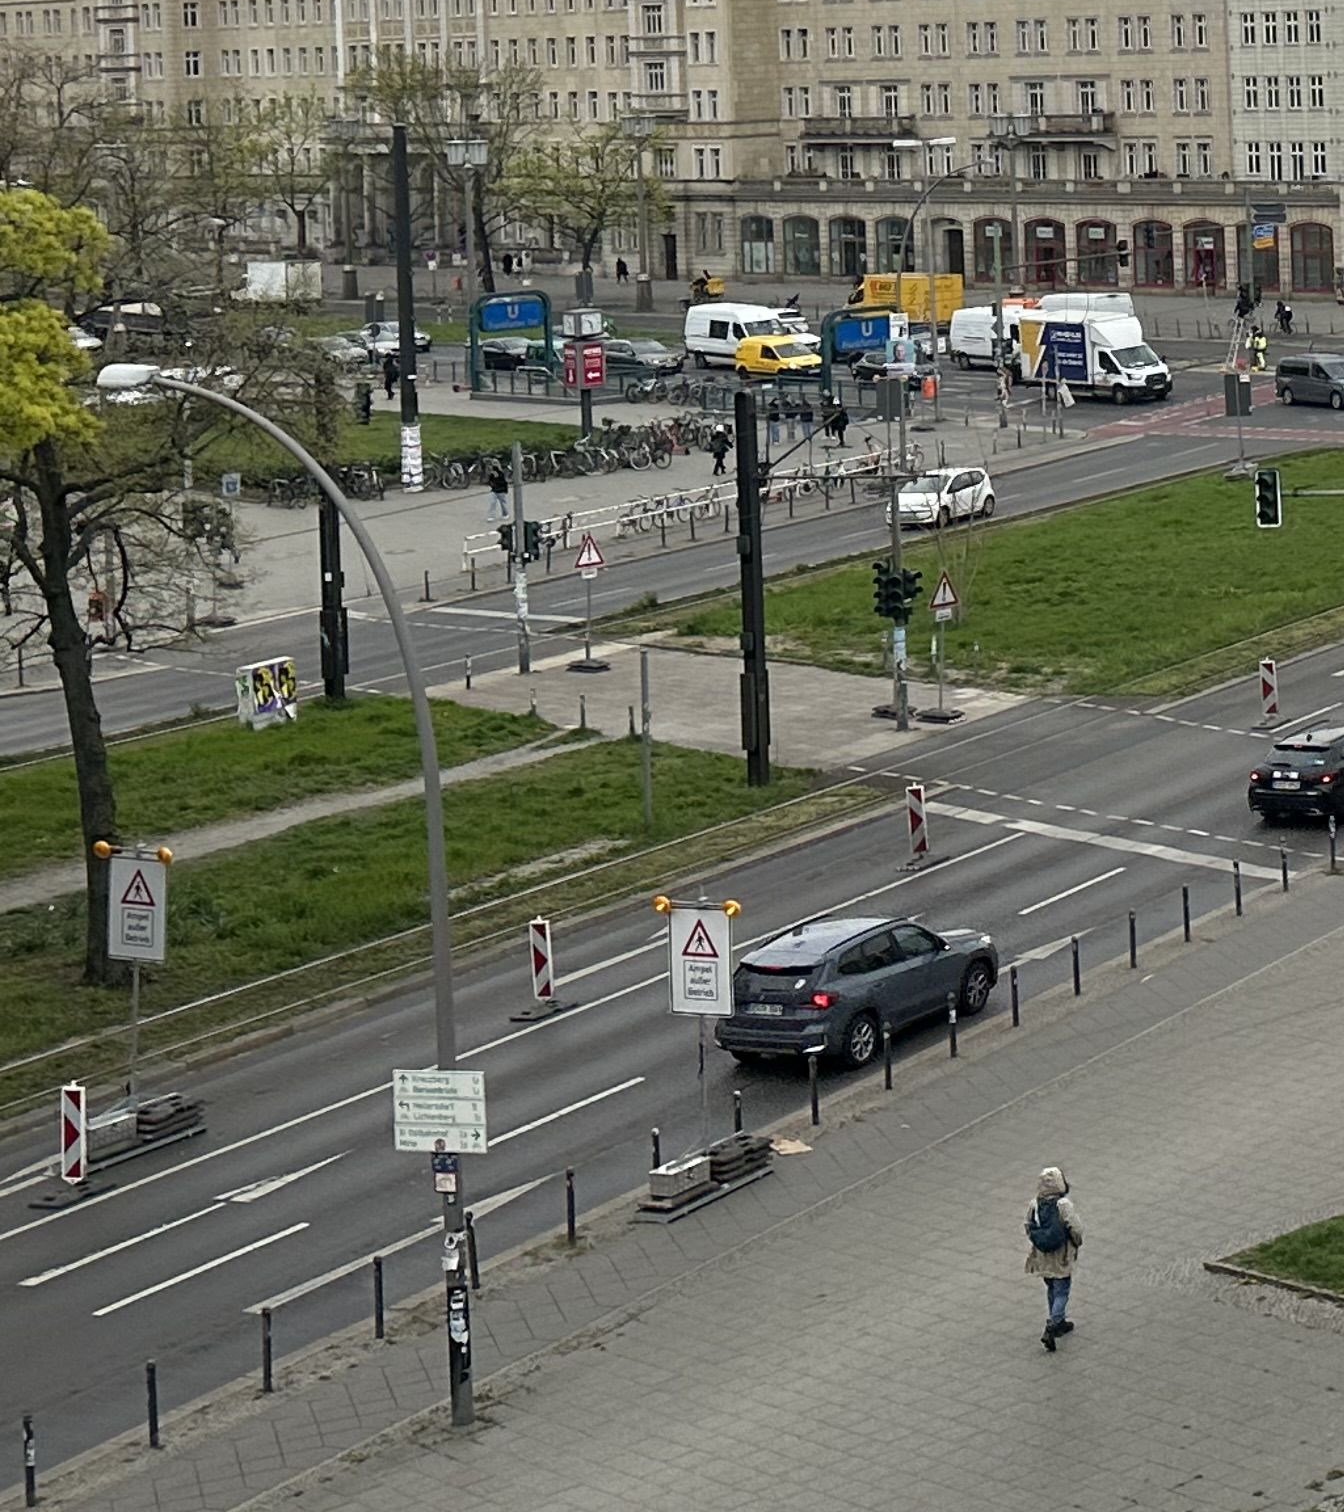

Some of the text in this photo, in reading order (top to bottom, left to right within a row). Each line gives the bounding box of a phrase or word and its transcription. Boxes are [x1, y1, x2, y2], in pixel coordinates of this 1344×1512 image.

[507, 304, 519, 319] U
[861, 321, 873, 337] U
[688, 964, 712, 974] Ampel
